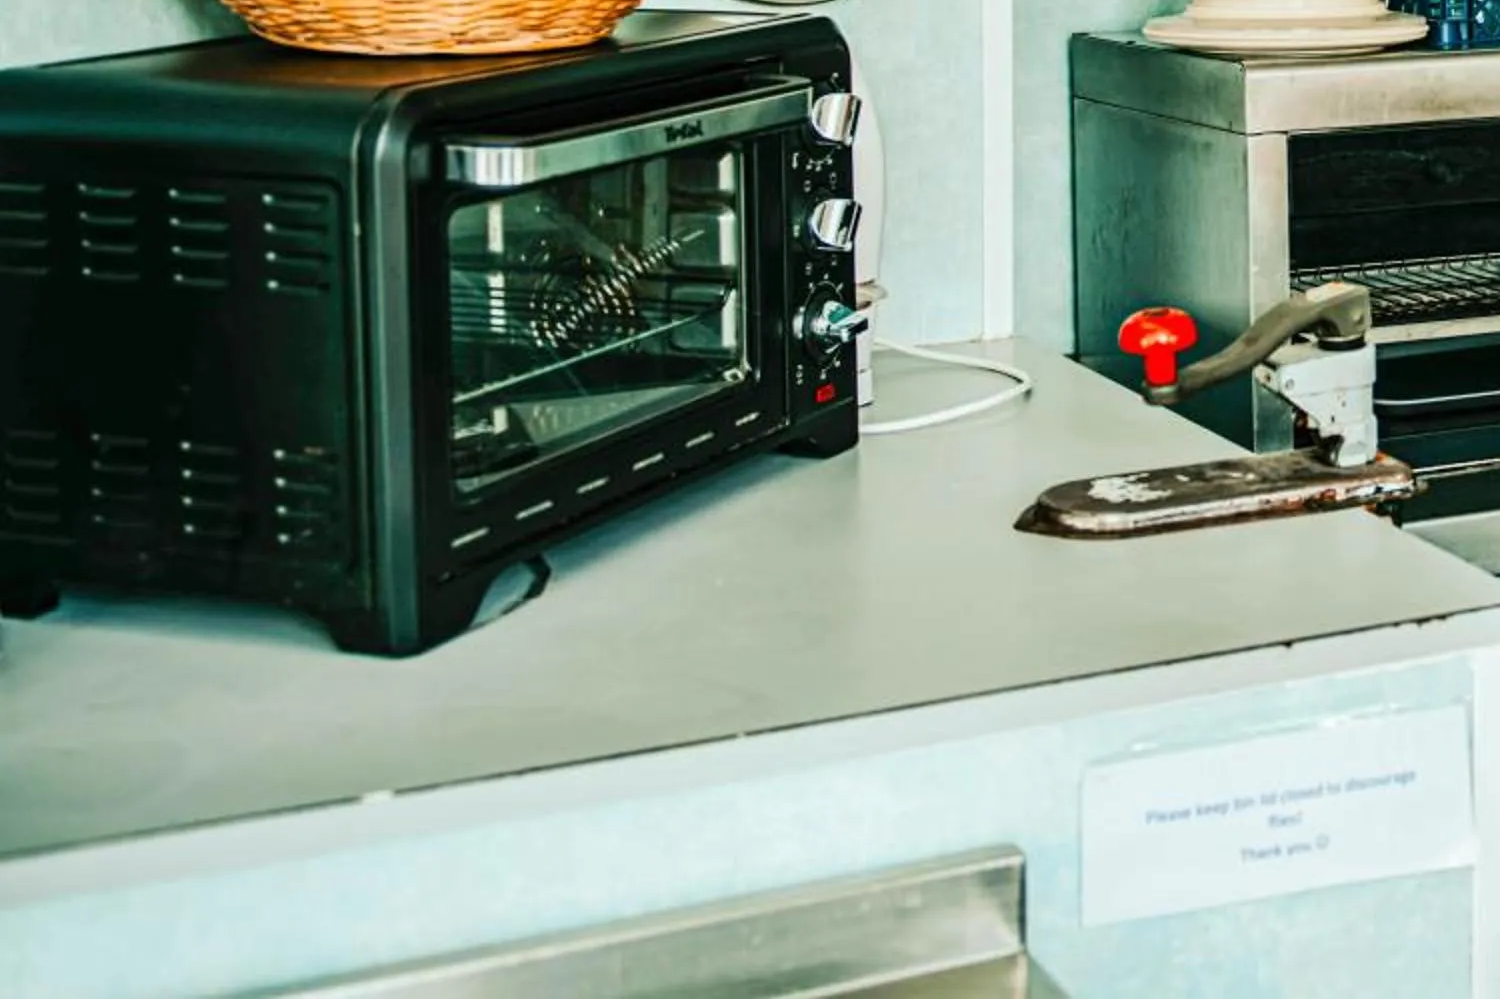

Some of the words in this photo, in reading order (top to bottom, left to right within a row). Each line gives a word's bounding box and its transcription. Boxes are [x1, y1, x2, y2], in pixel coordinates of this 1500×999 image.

[1145, 808, 1191, 824] Please
[1195, 802, 1230, 817] keep
[1280, 781, 1323, 802] closed
[1326, 780, 1341, 795] to
[1344, 770, 1416, 792] discourage
[1240, 843, 1282, 864] Thank
[1287, 842, 1312, 857] you
